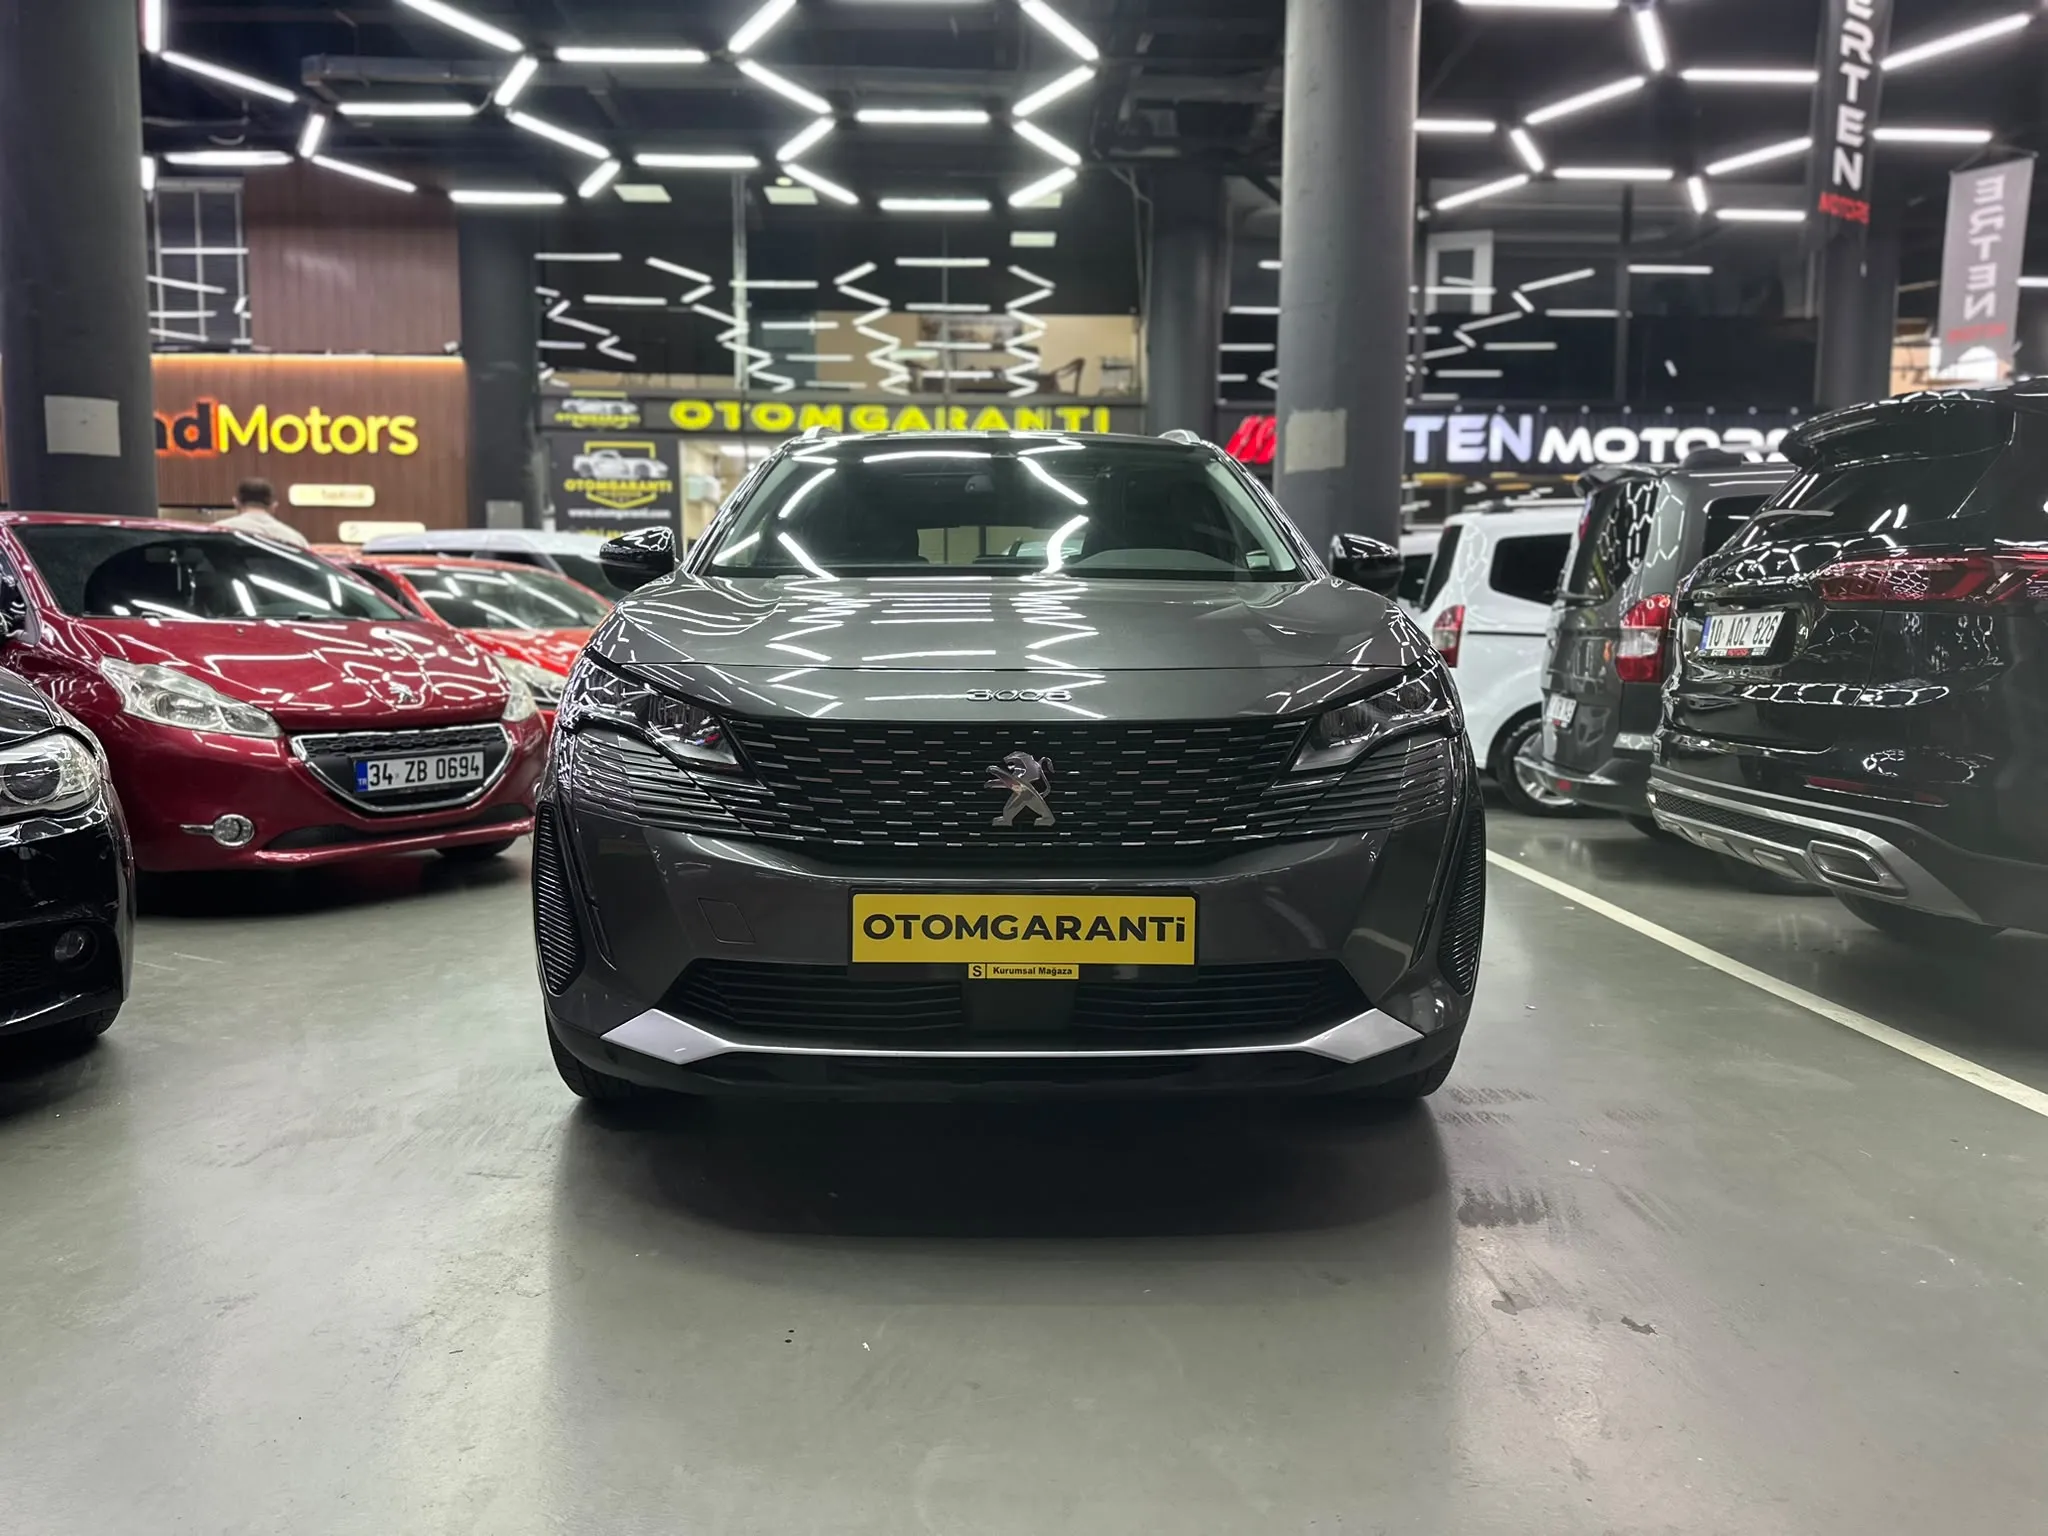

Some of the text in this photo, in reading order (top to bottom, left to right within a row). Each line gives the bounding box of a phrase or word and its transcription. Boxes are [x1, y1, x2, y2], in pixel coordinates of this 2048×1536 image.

[669, 400, 1110, 433] OTOMGARANTI
[1403, 414, 1533, 463] TEN
[1708, 618, 1724, 646] 10
[1752, 615, 1779, 645] 826
[966, 688, 1072, 701] 3008
[369, 755, 480, 786] 34 ZB 0694
[972, 965, 1073, 977] S Kurumsal Mağaza
